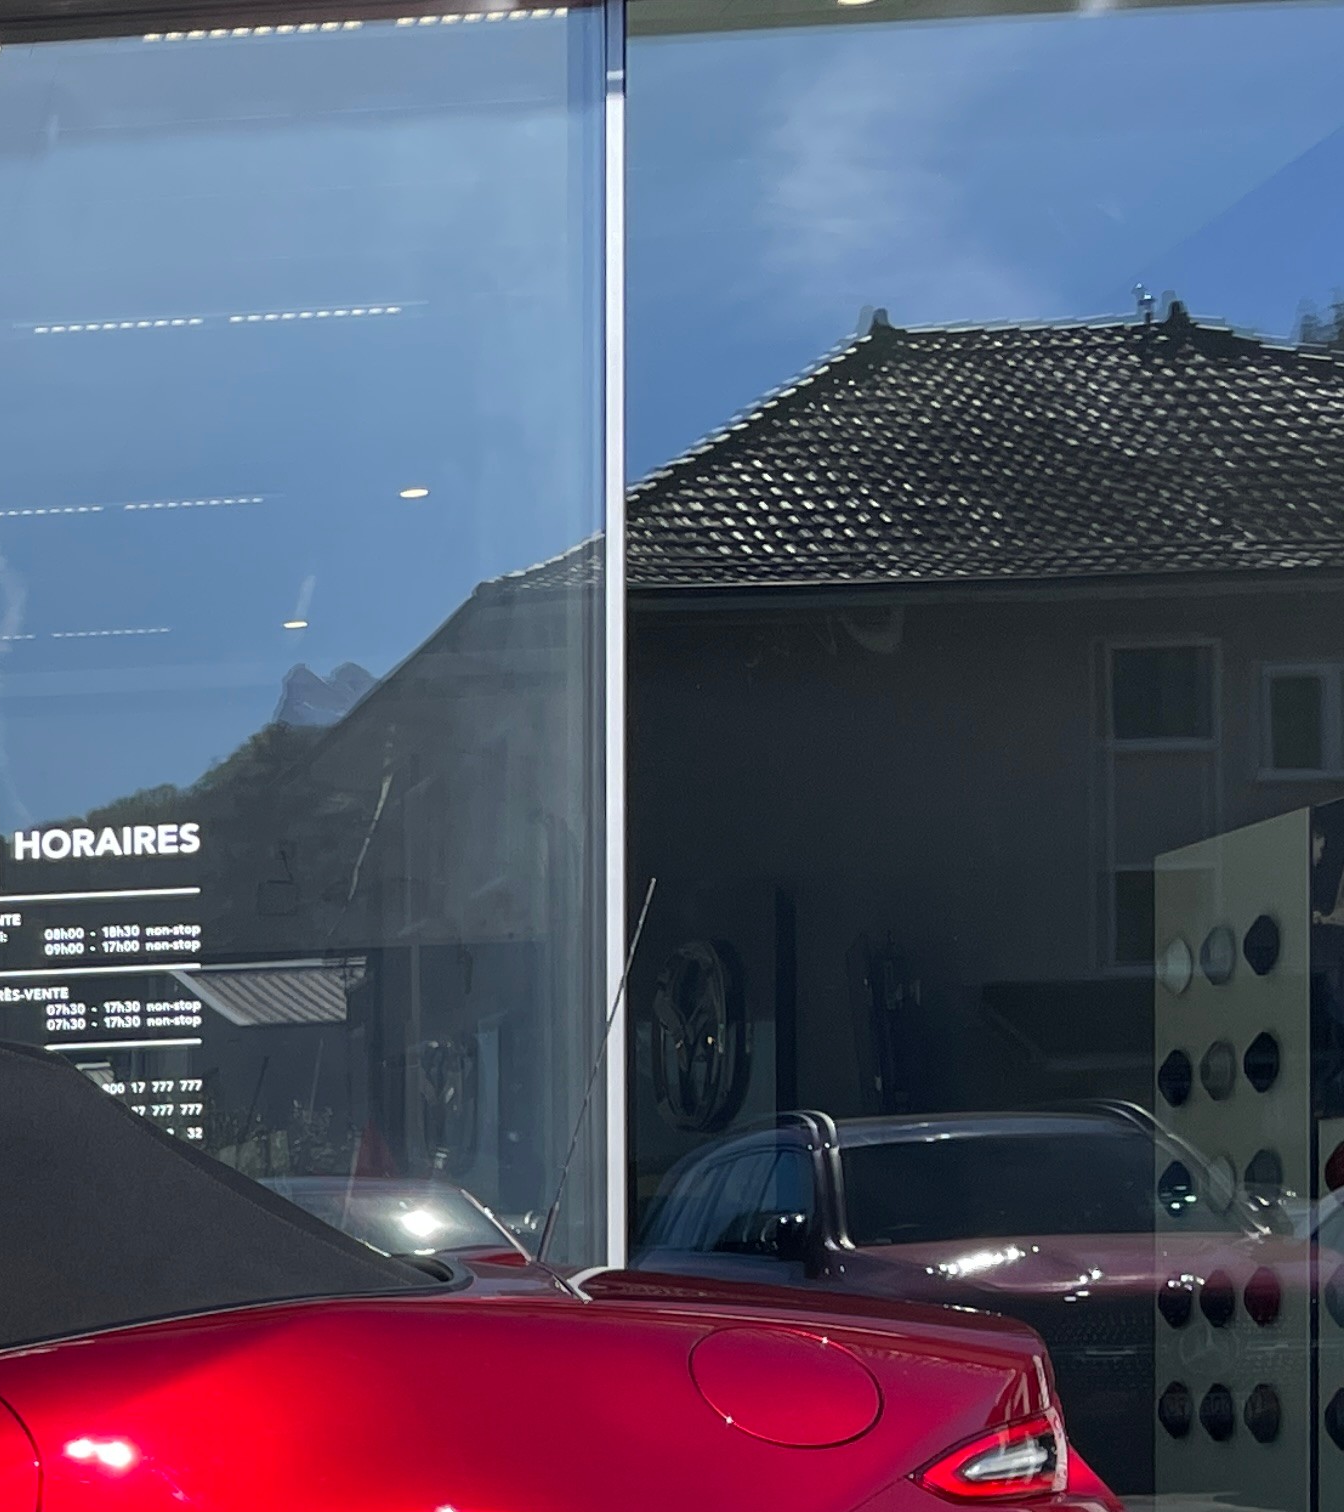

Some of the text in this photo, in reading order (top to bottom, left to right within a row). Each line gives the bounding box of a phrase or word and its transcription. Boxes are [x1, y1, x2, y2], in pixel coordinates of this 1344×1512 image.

[14, 822, 201, 861] HORAIRES
[44, 927, 85, 941] 08h00
[145, 923, 202, 937] non-stop
[44, 942, 85, 955] 09h00
[101, 939, 141, 953] 17h00
[145, 939, 202, 953] non-stop
[45, 1002, 86, 1016] 07h30
[103, 1000, 141, 1014] 17h30
[146, 999, 202, 1013] non-stop
[46, 1017, 87, 1031] 07h30
[103, 1015, 141, 1028] 17h30
[146, 1014, 202, 1028] non-stop
[131, 1081, 146, 1094] 17
[151, 1080, 174, 1093] 777
[179, 1079, 203, 1092] 777
[151, 1104, 174, 1117] 777
[179, 1103, 204, 1116] 777
[186, 1126, 204, 1140] 32
